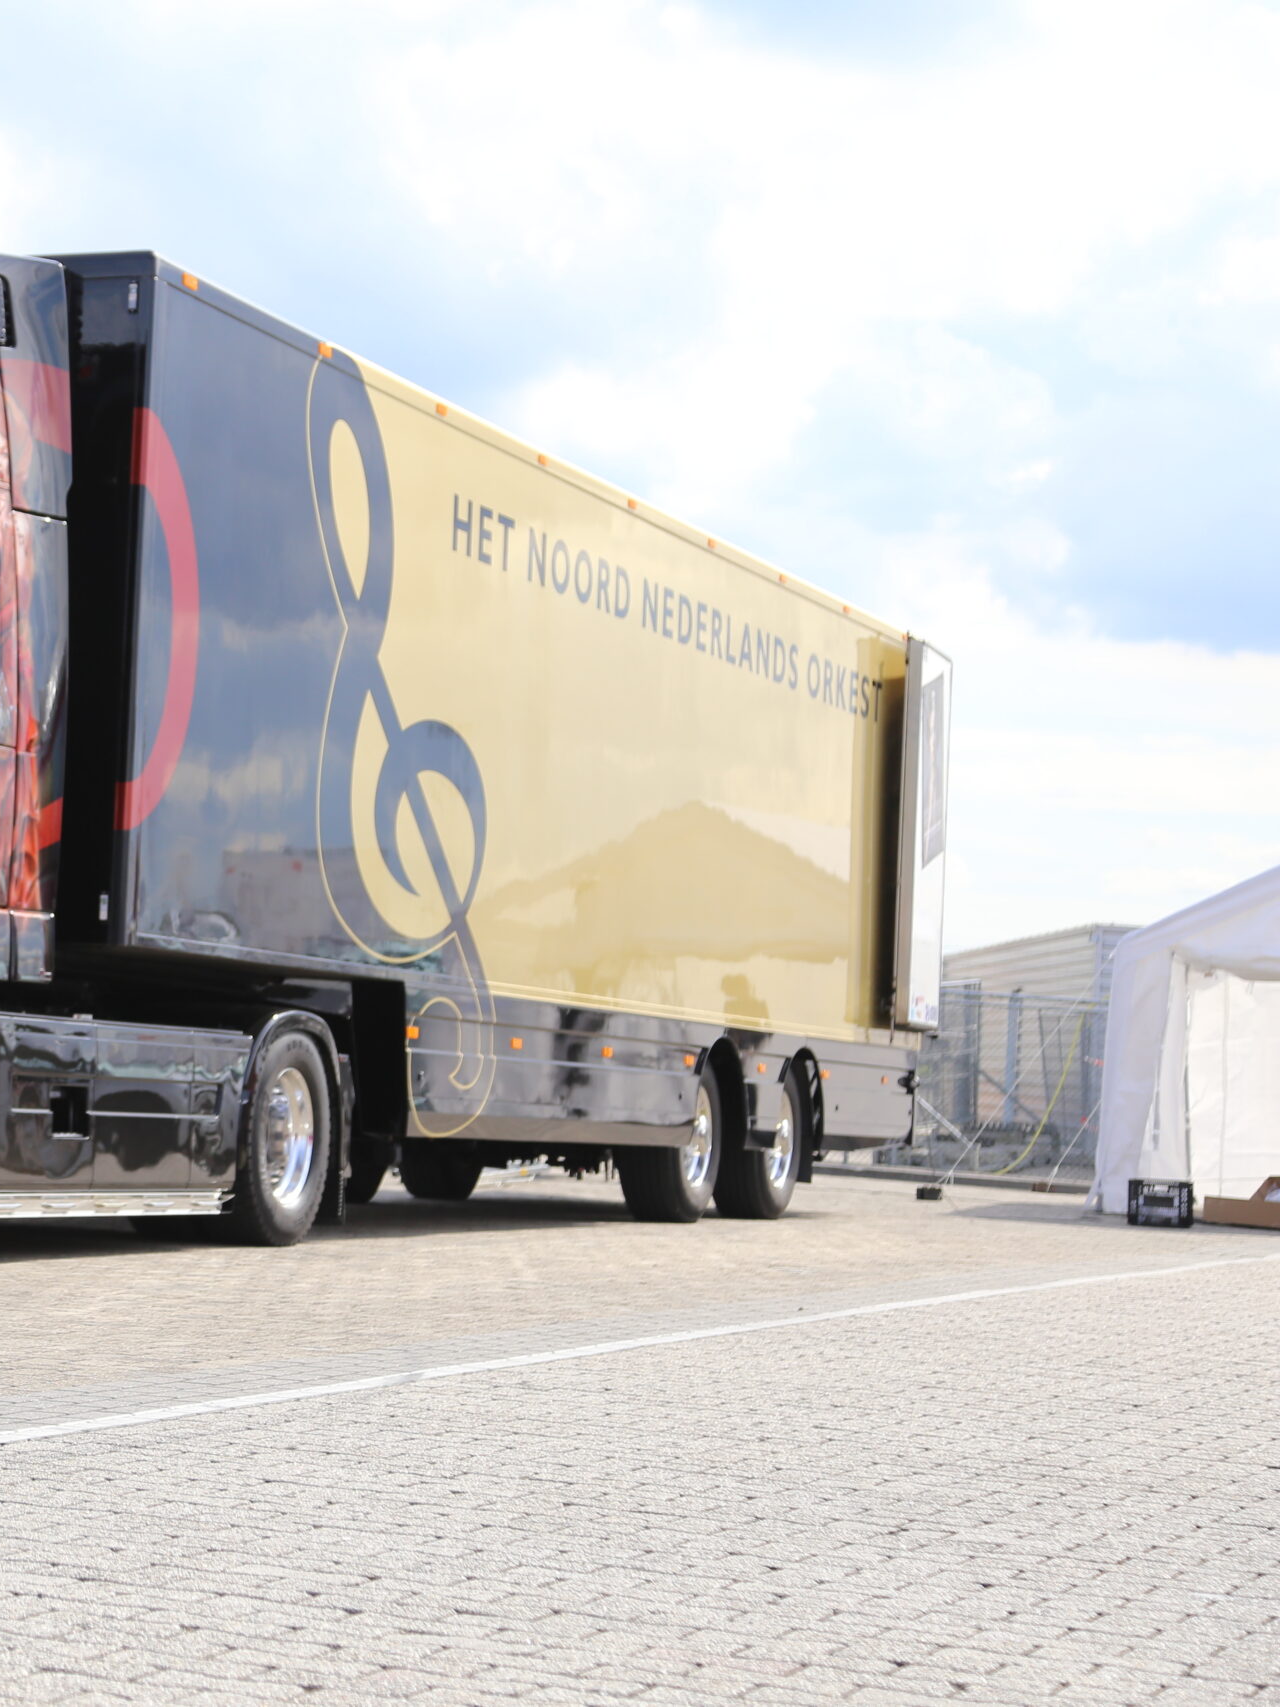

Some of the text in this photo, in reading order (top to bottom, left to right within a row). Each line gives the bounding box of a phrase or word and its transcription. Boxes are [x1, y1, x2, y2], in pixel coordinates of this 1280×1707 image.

[452, 493, 883, 723] HET NOORD NEDERLANDS ORKEST
